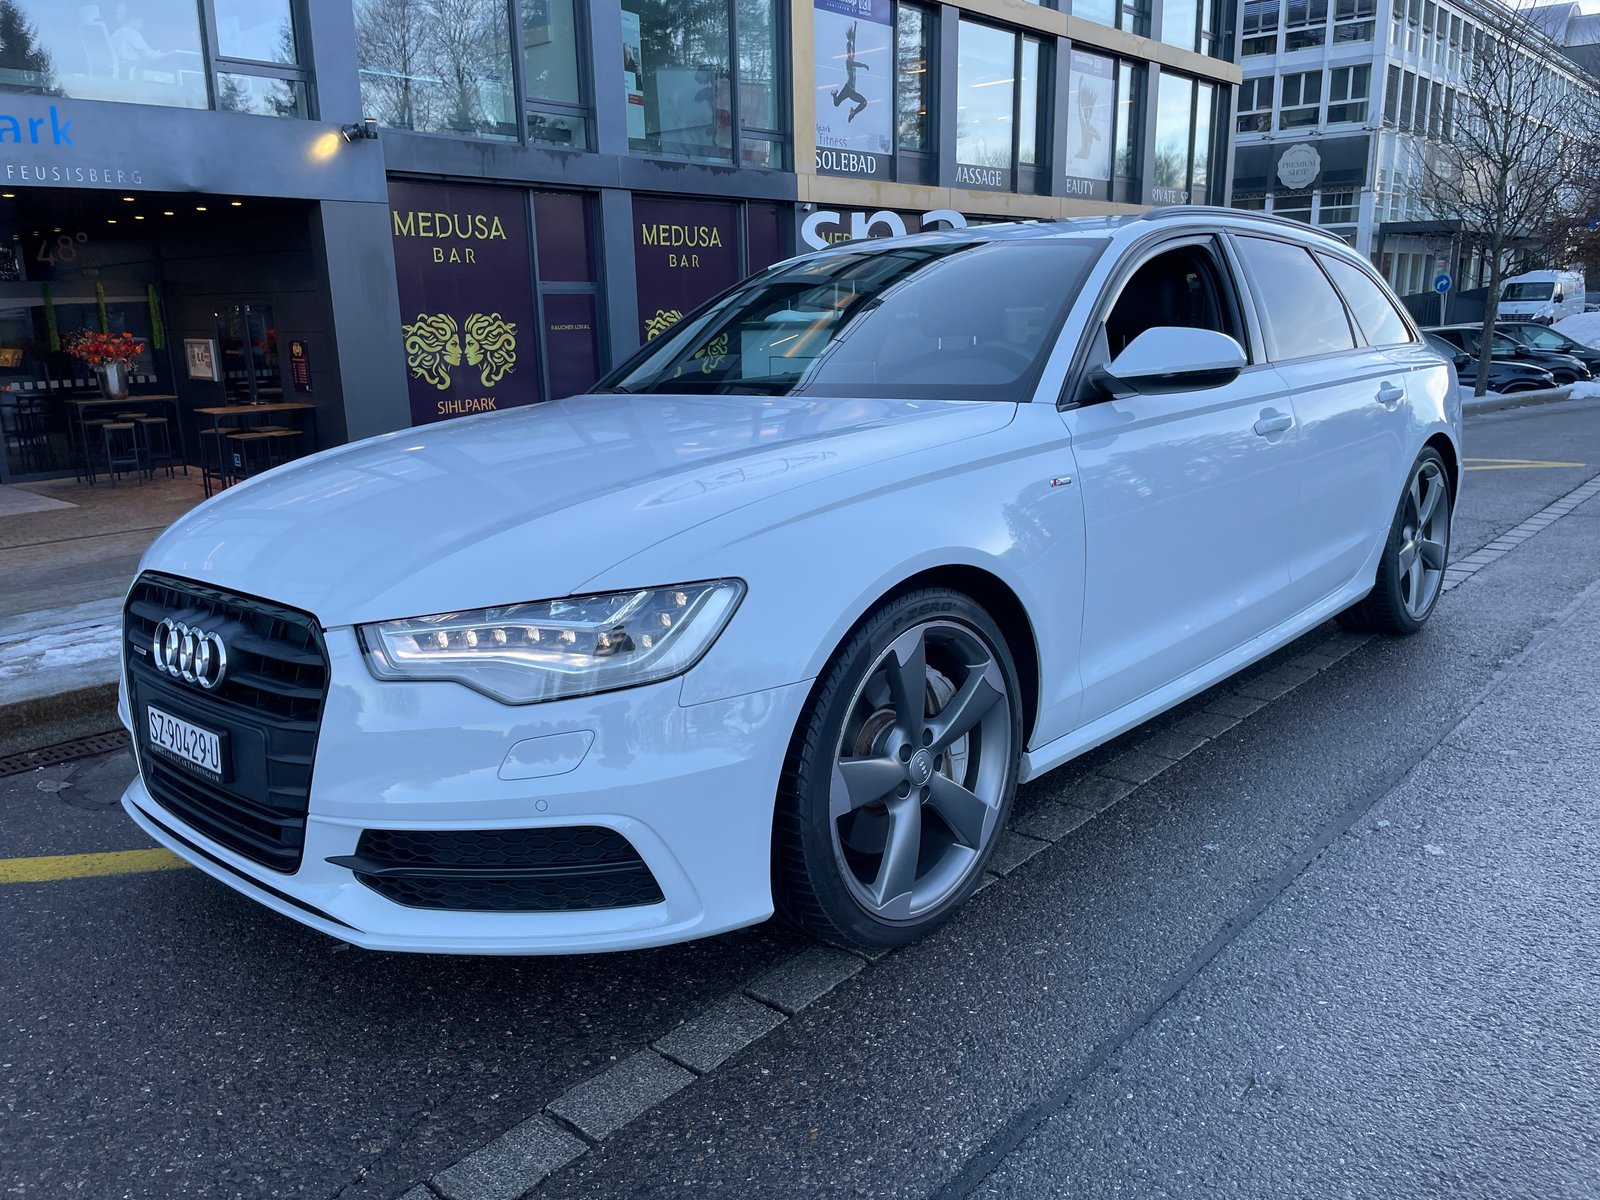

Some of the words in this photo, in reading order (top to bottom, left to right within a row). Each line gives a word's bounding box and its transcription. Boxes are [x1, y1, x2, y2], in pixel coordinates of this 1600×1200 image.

[819, 133, 848, 148] fitness
[816, 150, 876, 174] SOLEBAD
[6, 165, 142, 184] FEUSISBERG
[393, 210, 507, 240] MEDUSA
[641, 223, 722, 247] MEDUSA
[433, 247, 476, 264] BAR
[669, 253, 700, 267] BAR
[437, 396, 497, 415] SIHLPARK
